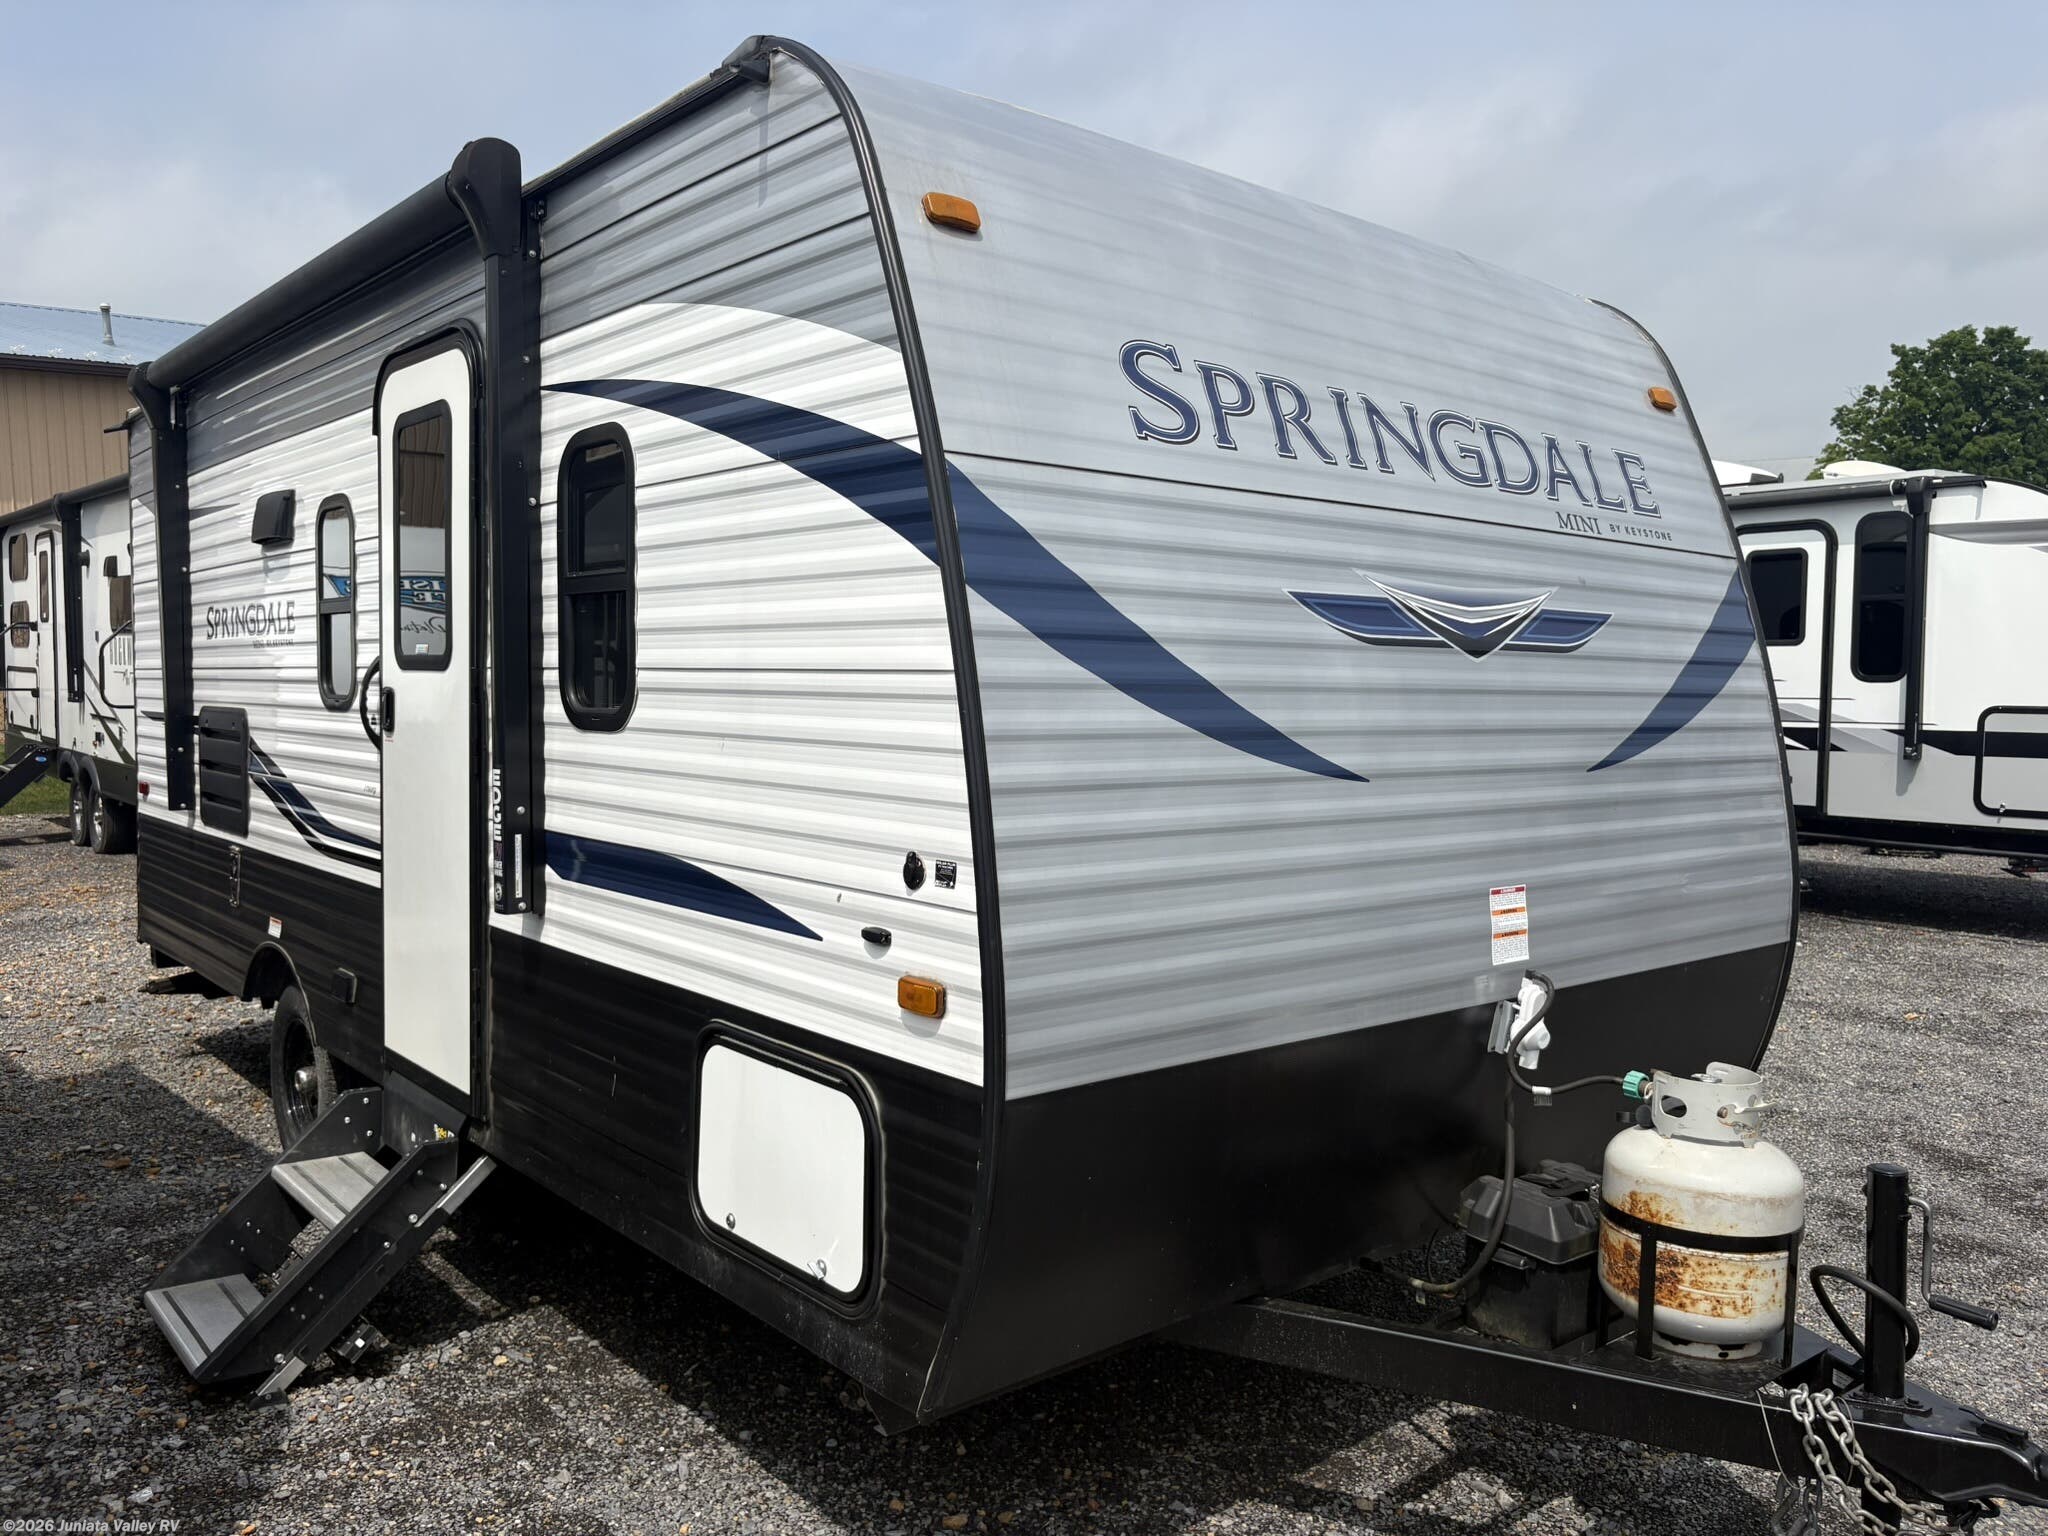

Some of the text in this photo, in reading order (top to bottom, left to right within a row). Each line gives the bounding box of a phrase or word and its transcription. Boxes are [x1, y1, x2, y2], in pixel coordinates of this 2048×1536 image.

[1118, 339, 1662, 518] SPRINGDALE
[1555, 511, 1673, 541] MINI BY KEYSTONE
[206, 600, 296, 640] SPRINGDALE
